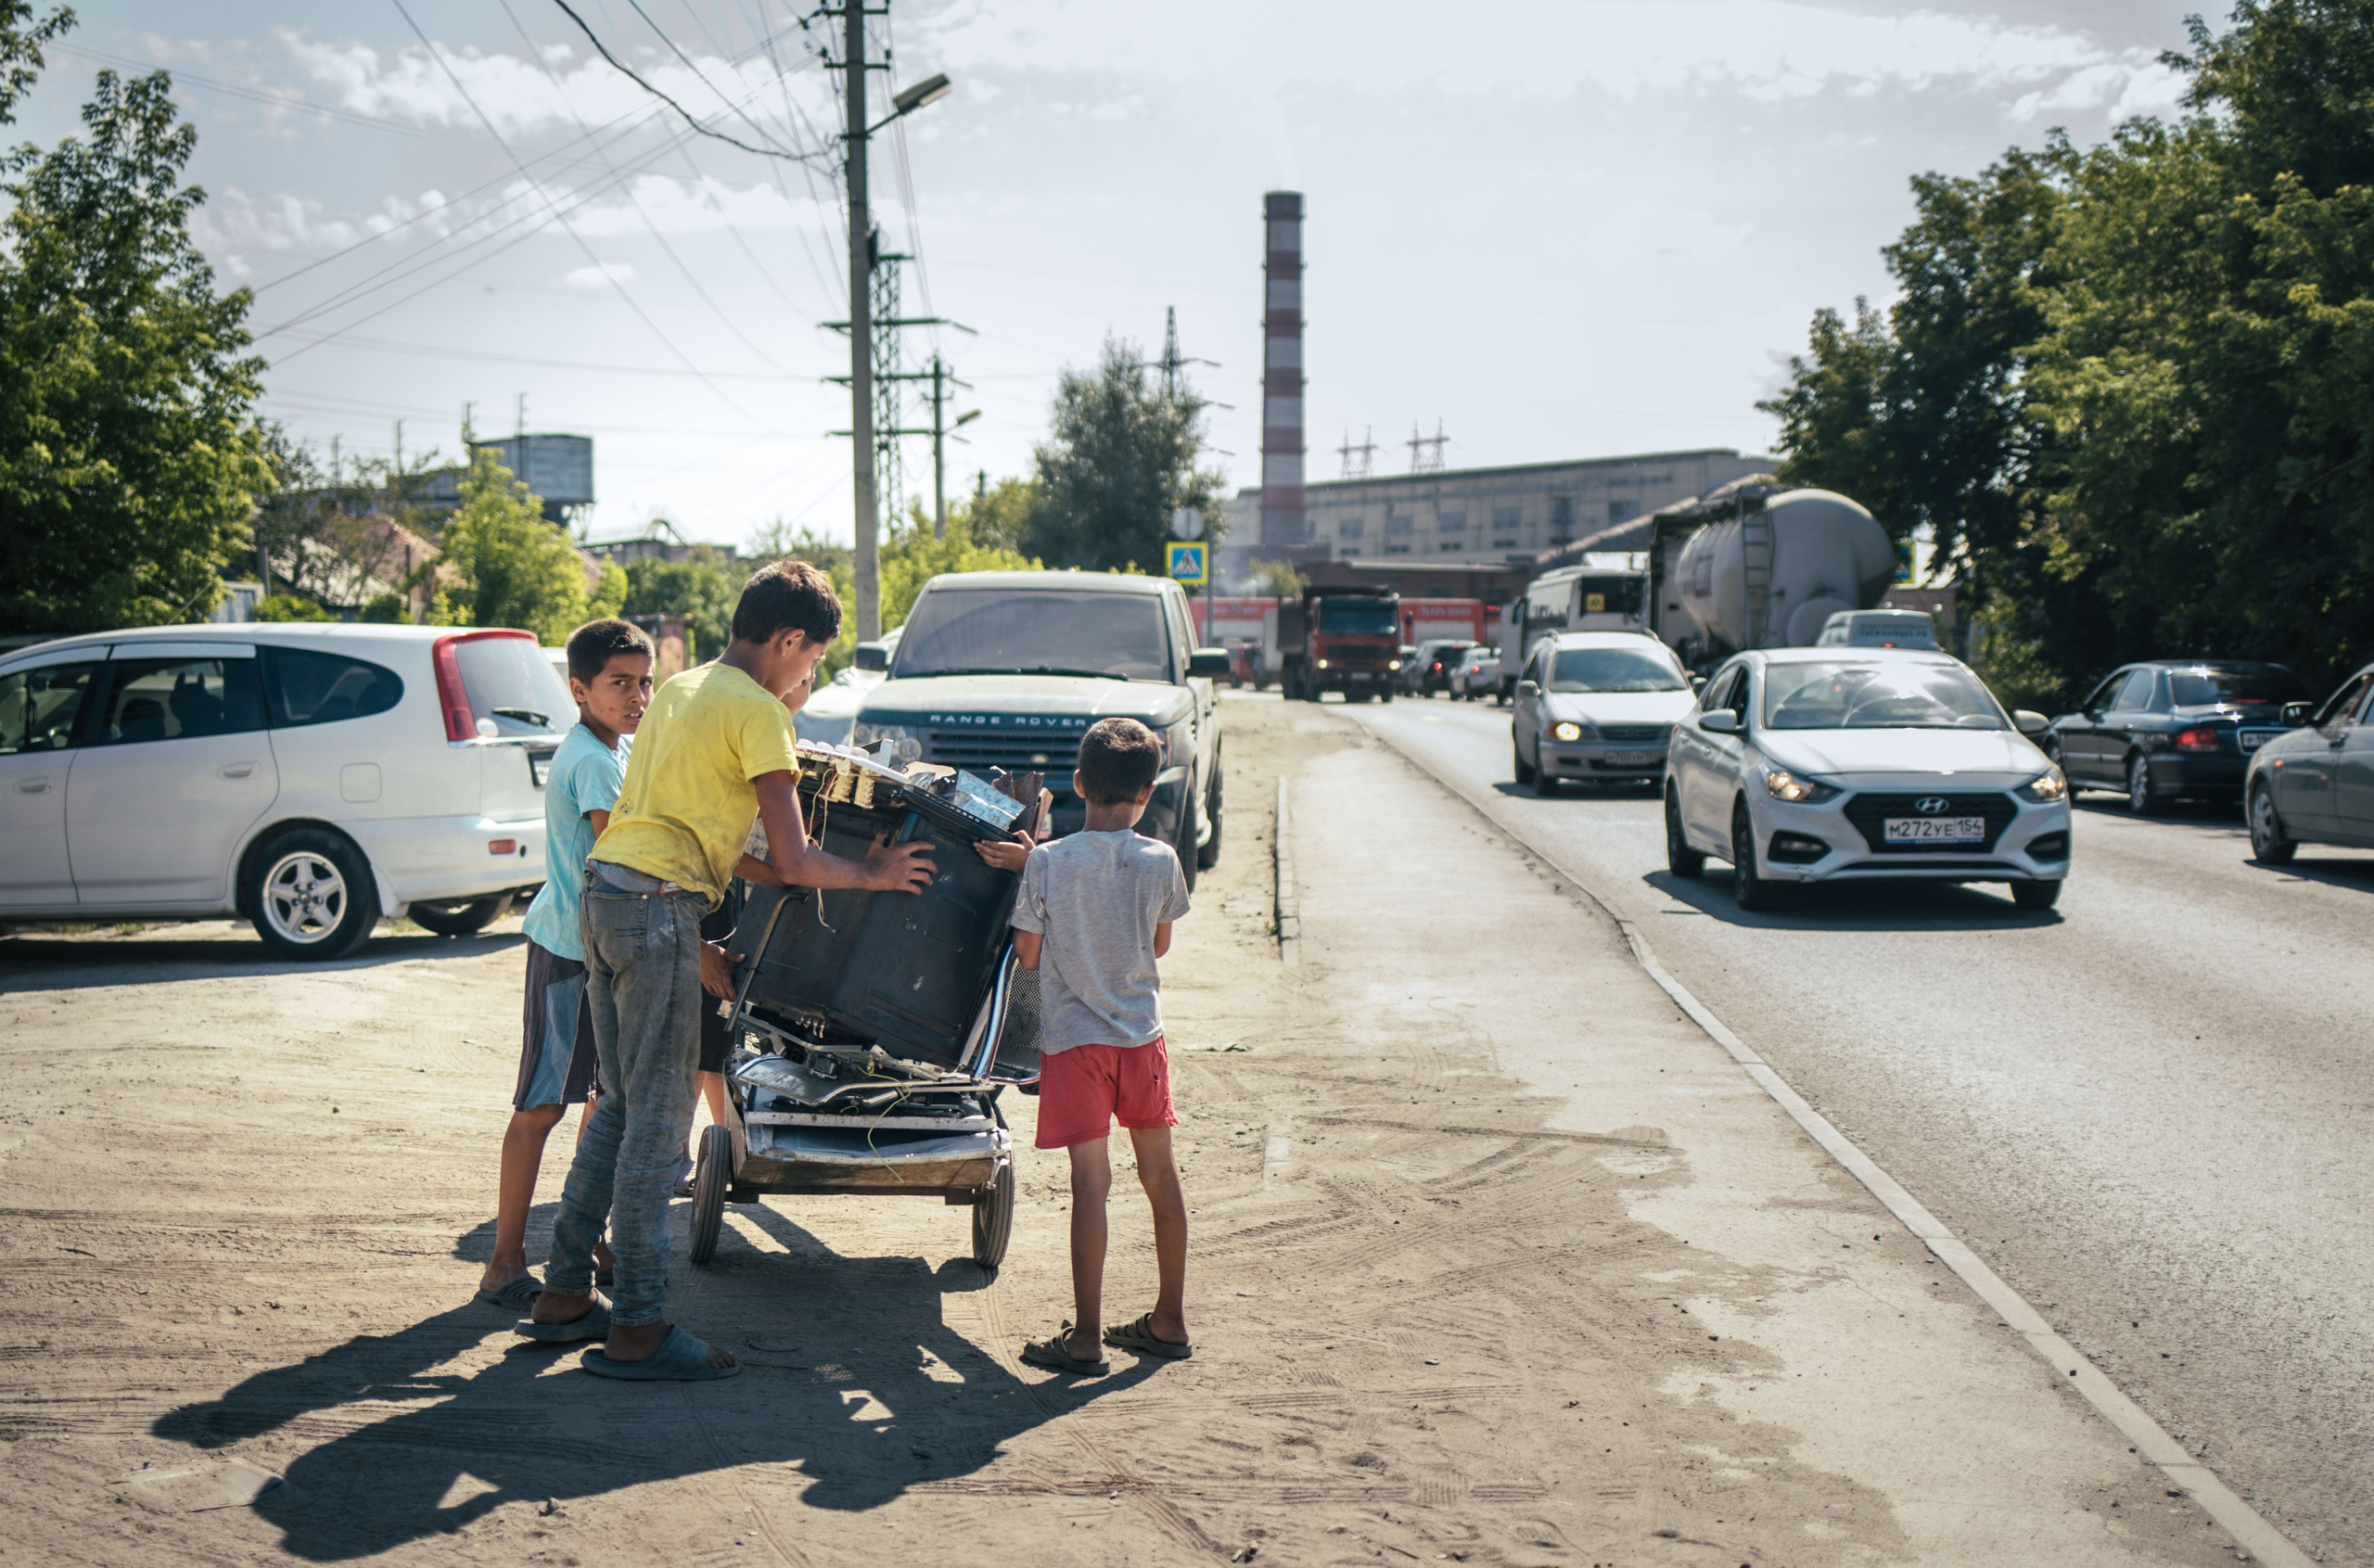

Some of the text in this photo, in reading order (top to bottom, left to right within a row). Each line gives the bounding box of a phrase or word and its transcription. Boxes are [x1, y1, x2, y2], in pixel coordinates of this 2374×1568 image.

[930, 715, 1087, 727] RANGE ROVER
[1957, 819, 1983, 833] 154
